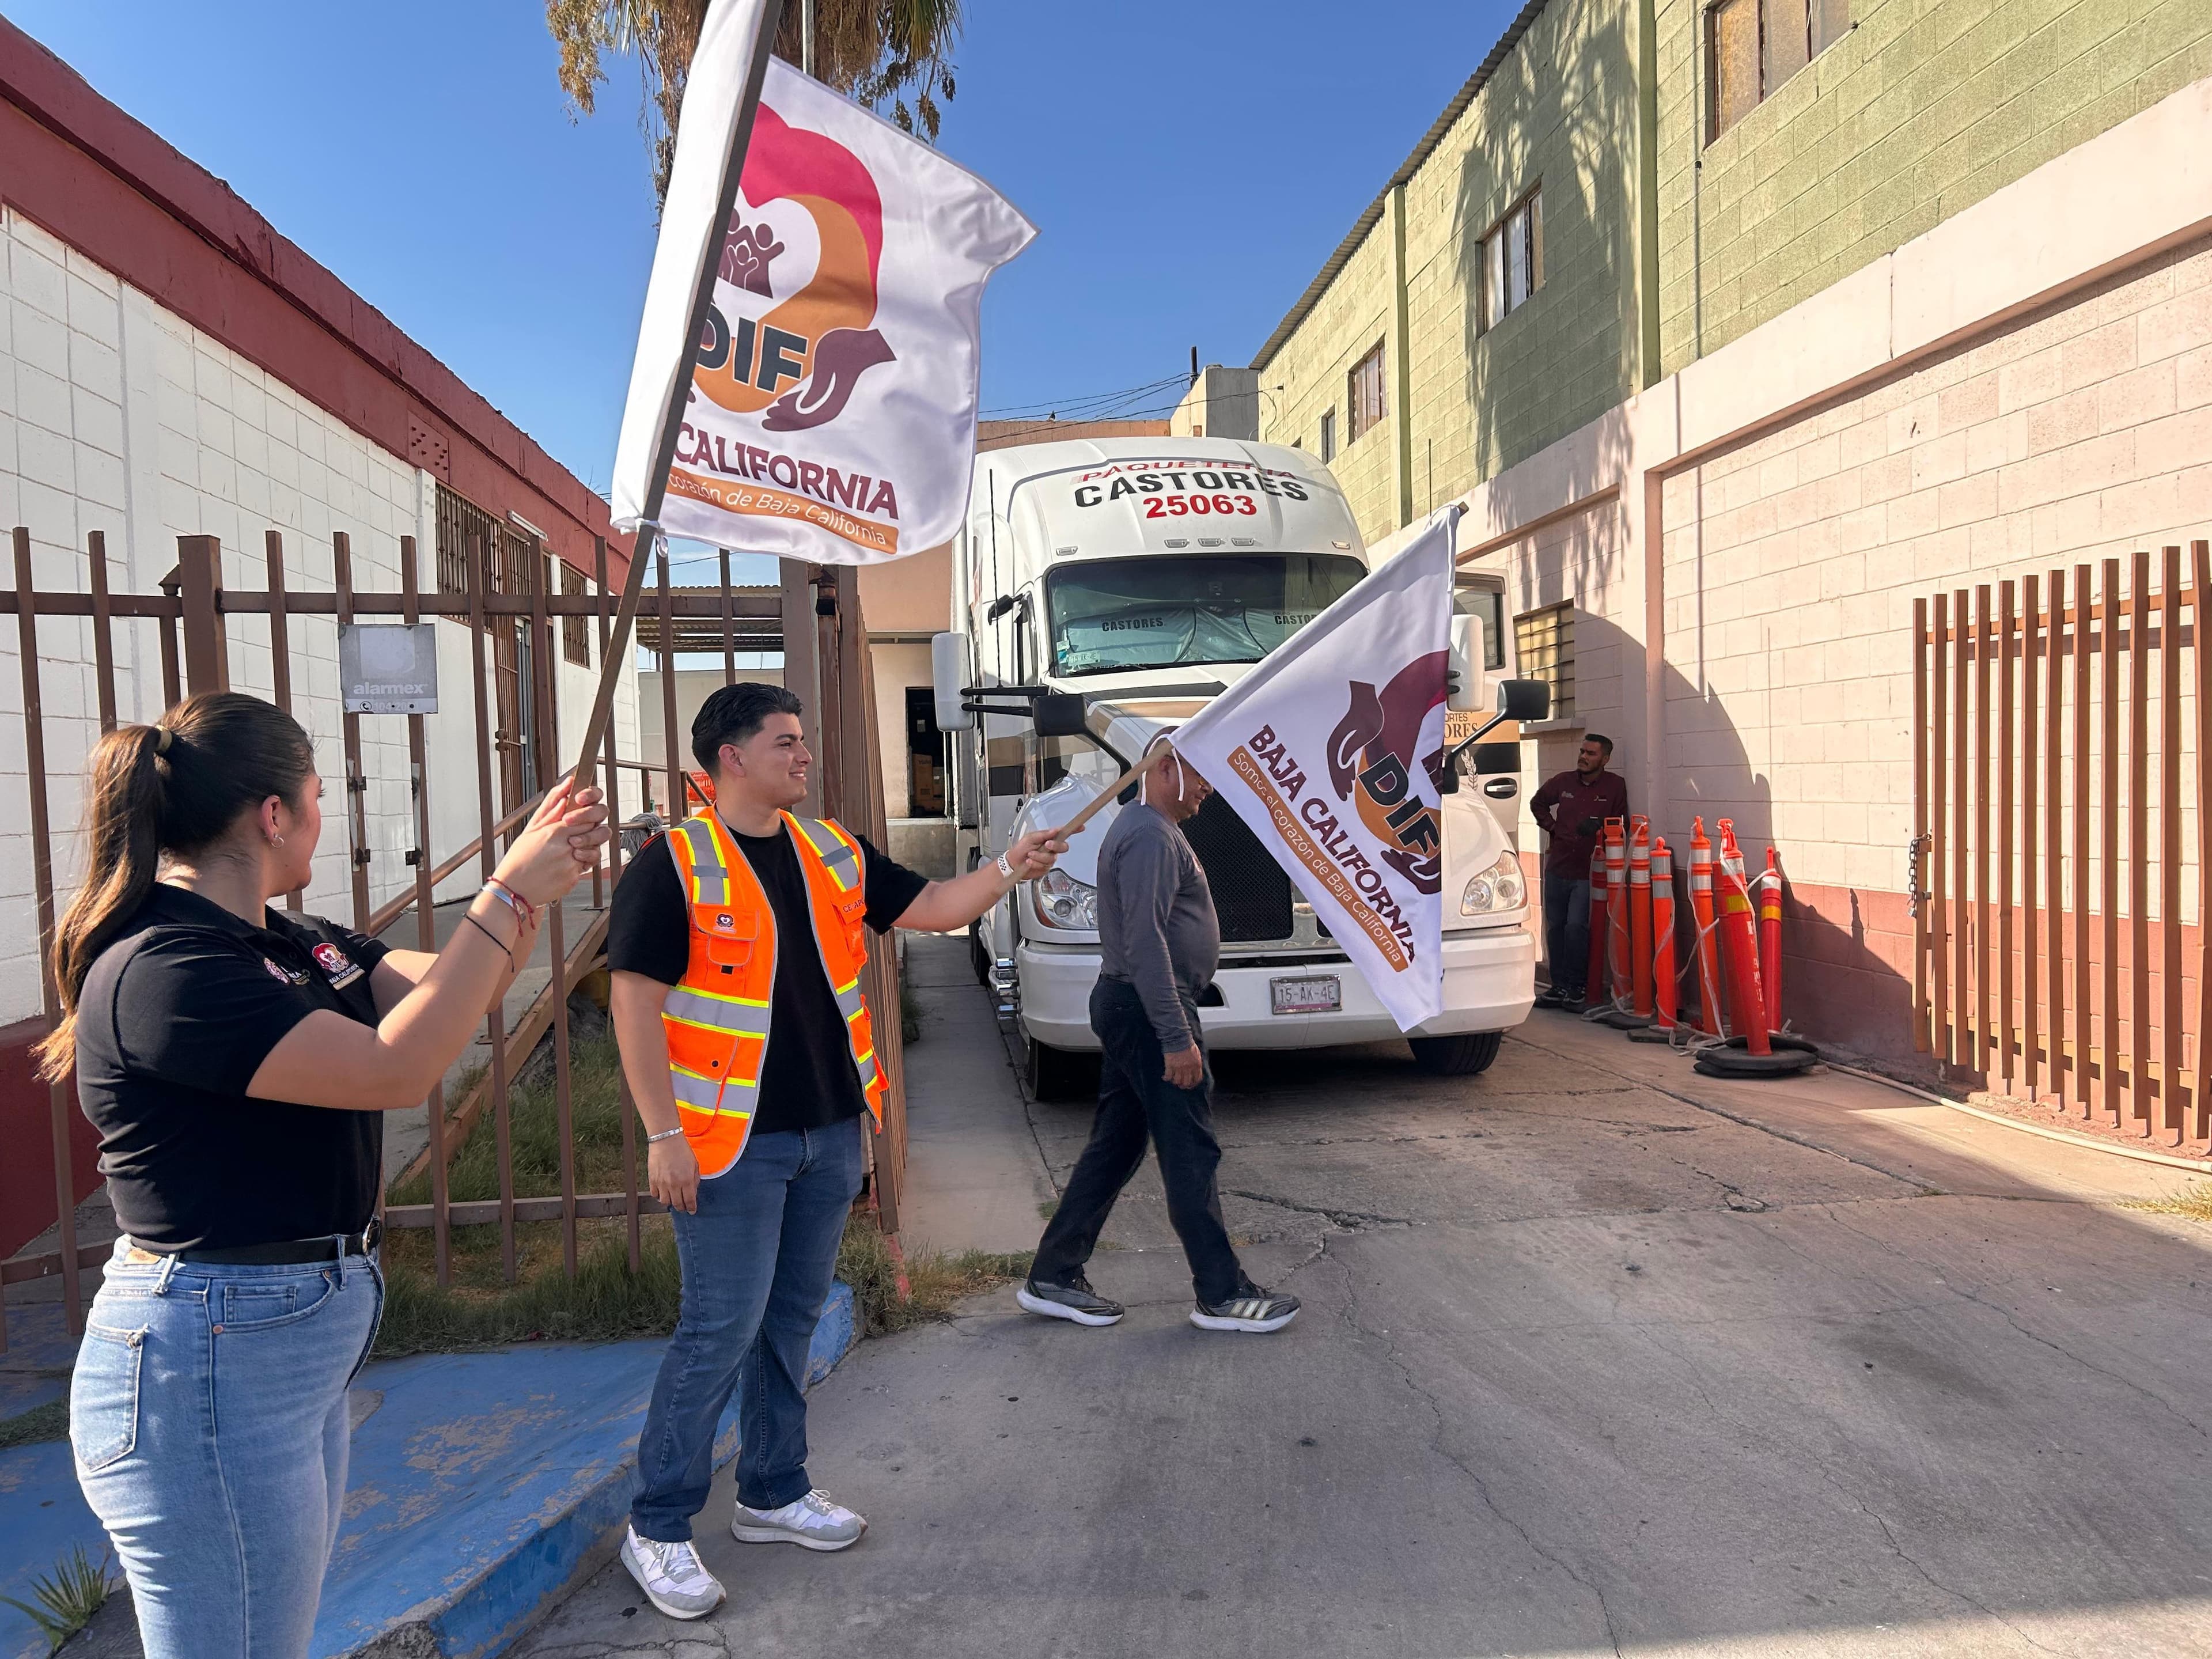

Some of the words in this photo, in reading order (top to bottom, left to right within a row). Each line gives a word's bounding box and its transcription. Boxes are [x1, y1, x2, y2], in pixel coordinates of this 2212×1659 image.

[696, 303, 809, 394] DIF
[673, 422, 899, 520] CALIFORNIA
[1074, 471, 1309, 508] CASTORES
[668, 473, 721, 503] corazón
[726, 488, 750, 507] de
[755, 494, 800, 514] Baja
[805, 503, 887, 546] California
[1143, 494, 1257, 518] 25063
[1101, 617, 1164, 632] CASTORES
[1274, 613, 1317, 625] CASTO
[353, 681, 424, 695] alarmex
[1357, 752, 1440, 855] DIF
[1234, 753, 1267, 796] Somos
[1267, 796, 1278, 810] el
[1274, 809, 1314, 859] corazón
[1312, 858, 1329, 875] de
[1326, 873, 1353, 903] Baja
[1352, 900, 1402, 963] California
[1248, 724, 1307, 802] BAJA
[1301, 797, 1415, 964] CALIFORNIA
[1279, 984, 1335, 1003] 15-AK-4E
